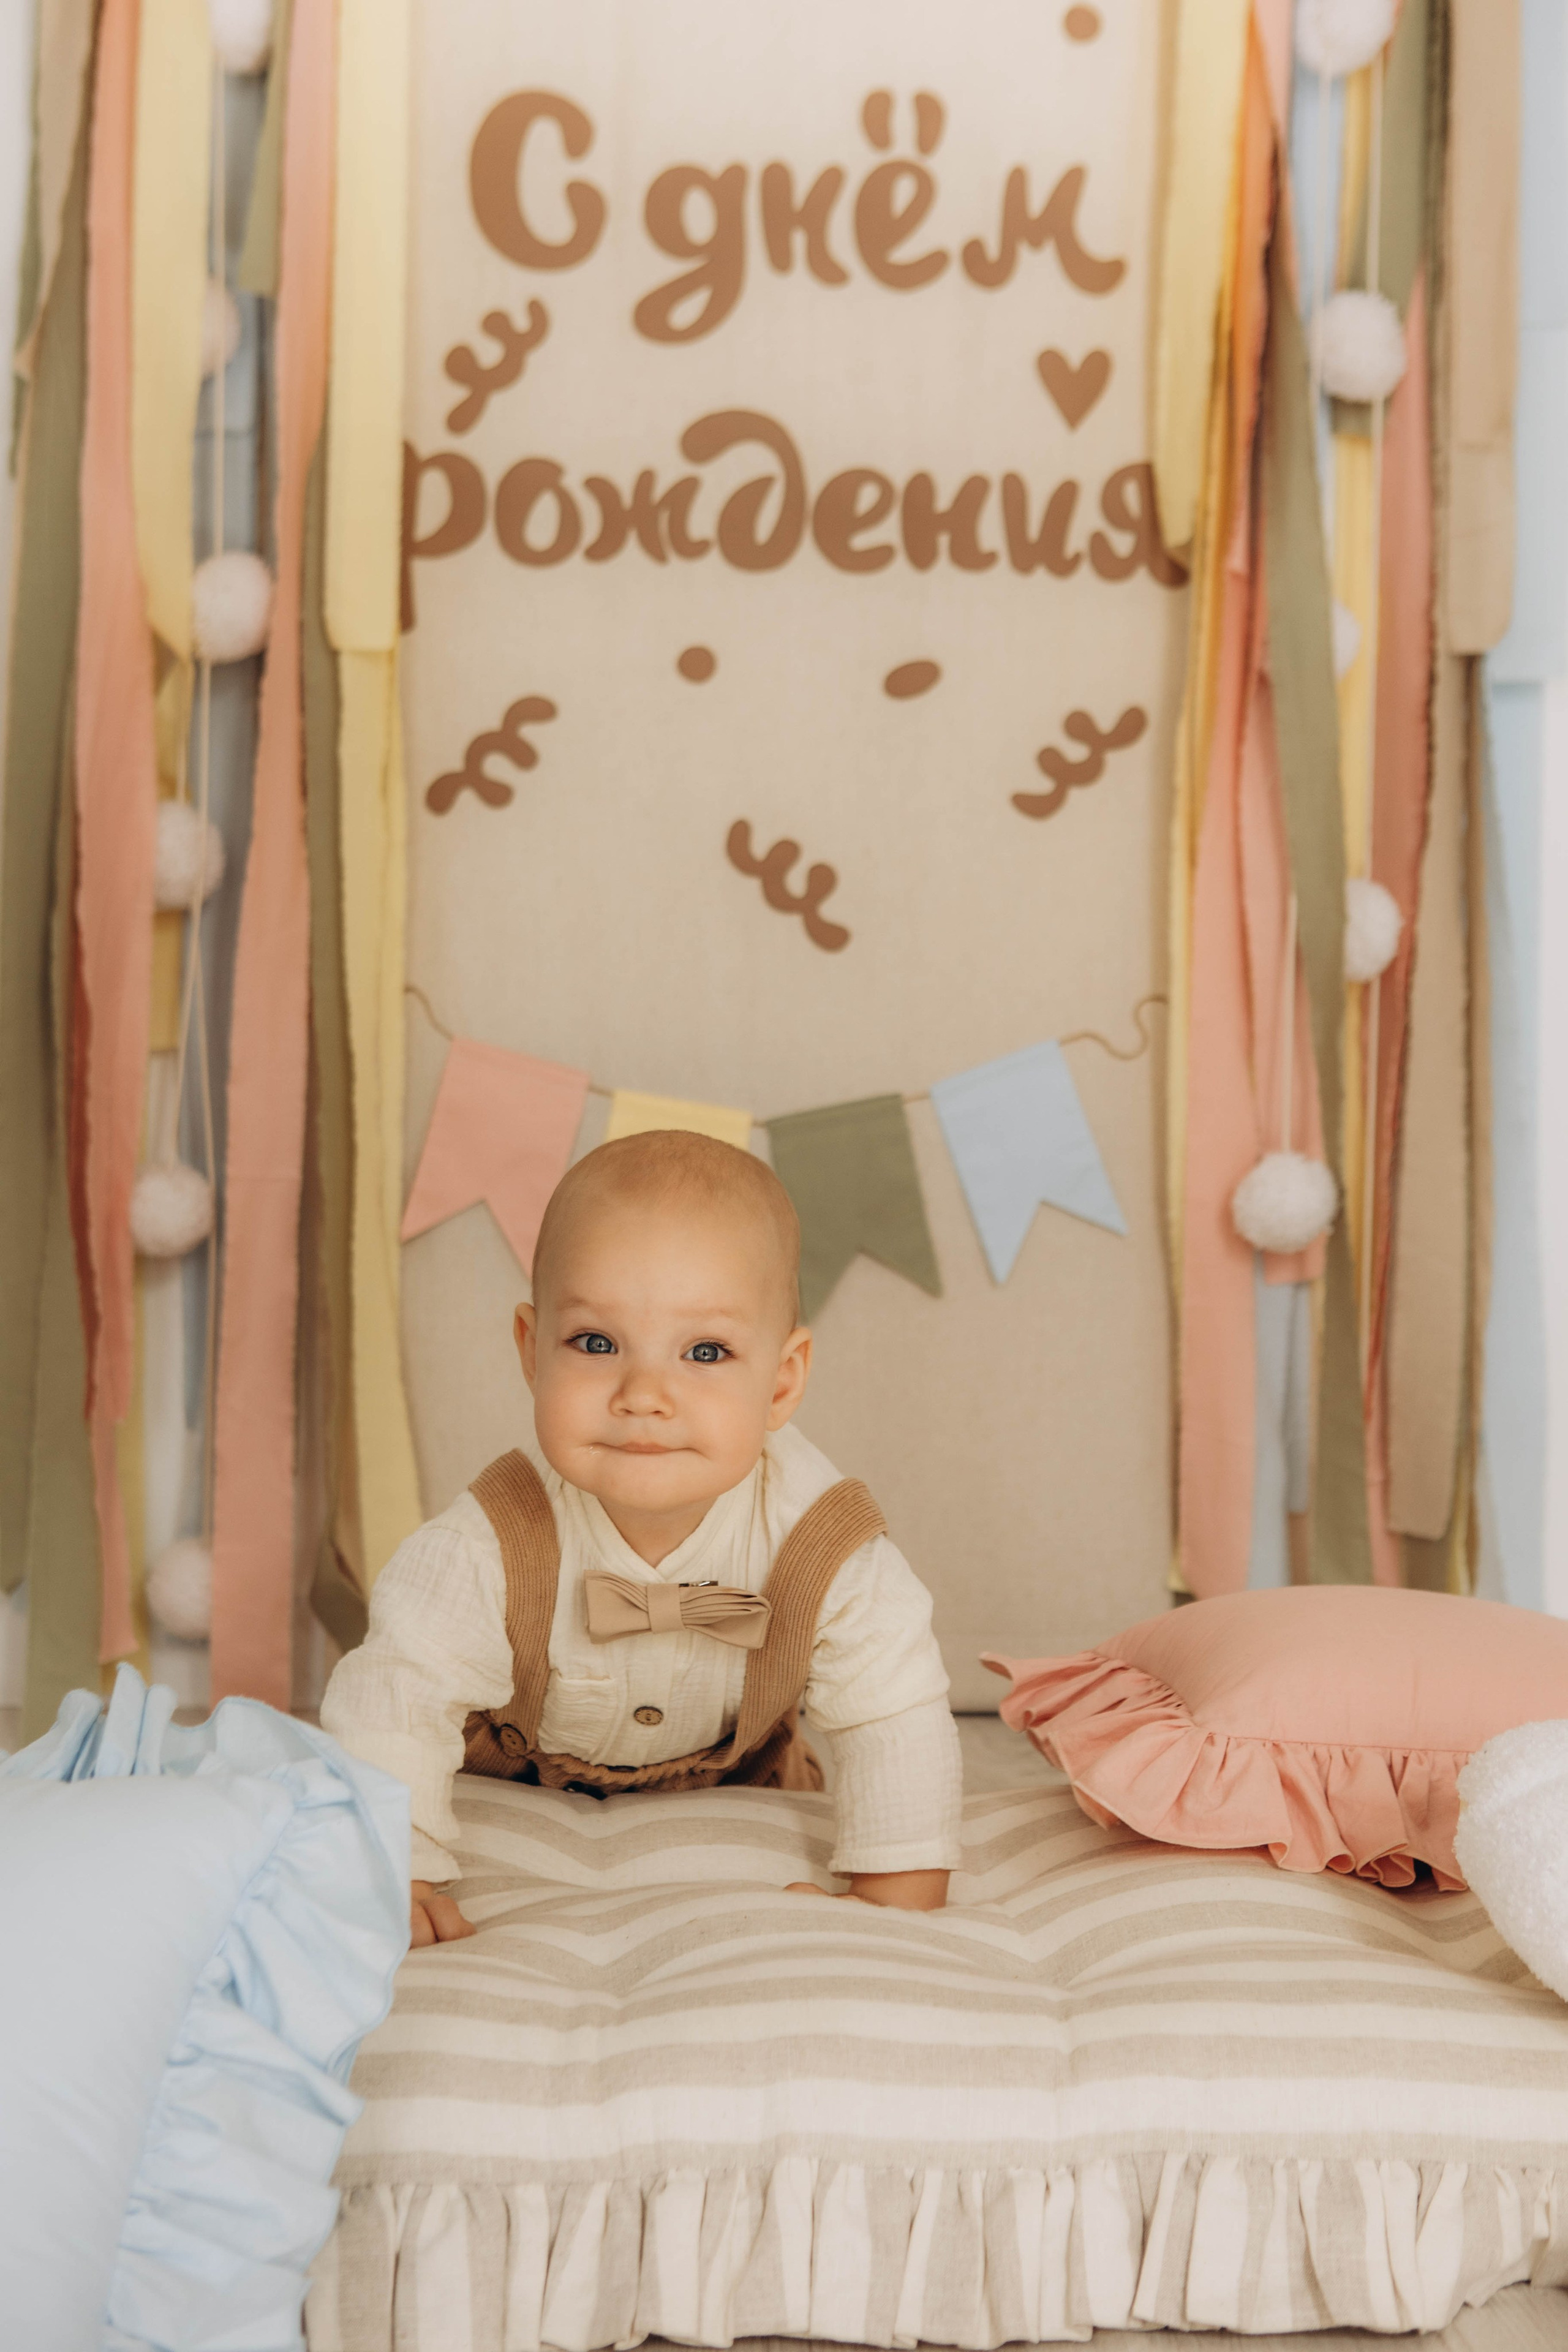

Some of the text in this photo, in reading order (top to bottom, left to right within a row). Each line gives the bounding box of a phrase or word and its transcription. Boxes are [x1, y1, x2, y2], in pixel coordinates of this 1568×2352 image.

[468, 88, 1128, 346] С днём
[399, 408, 1190, 635] рождения
